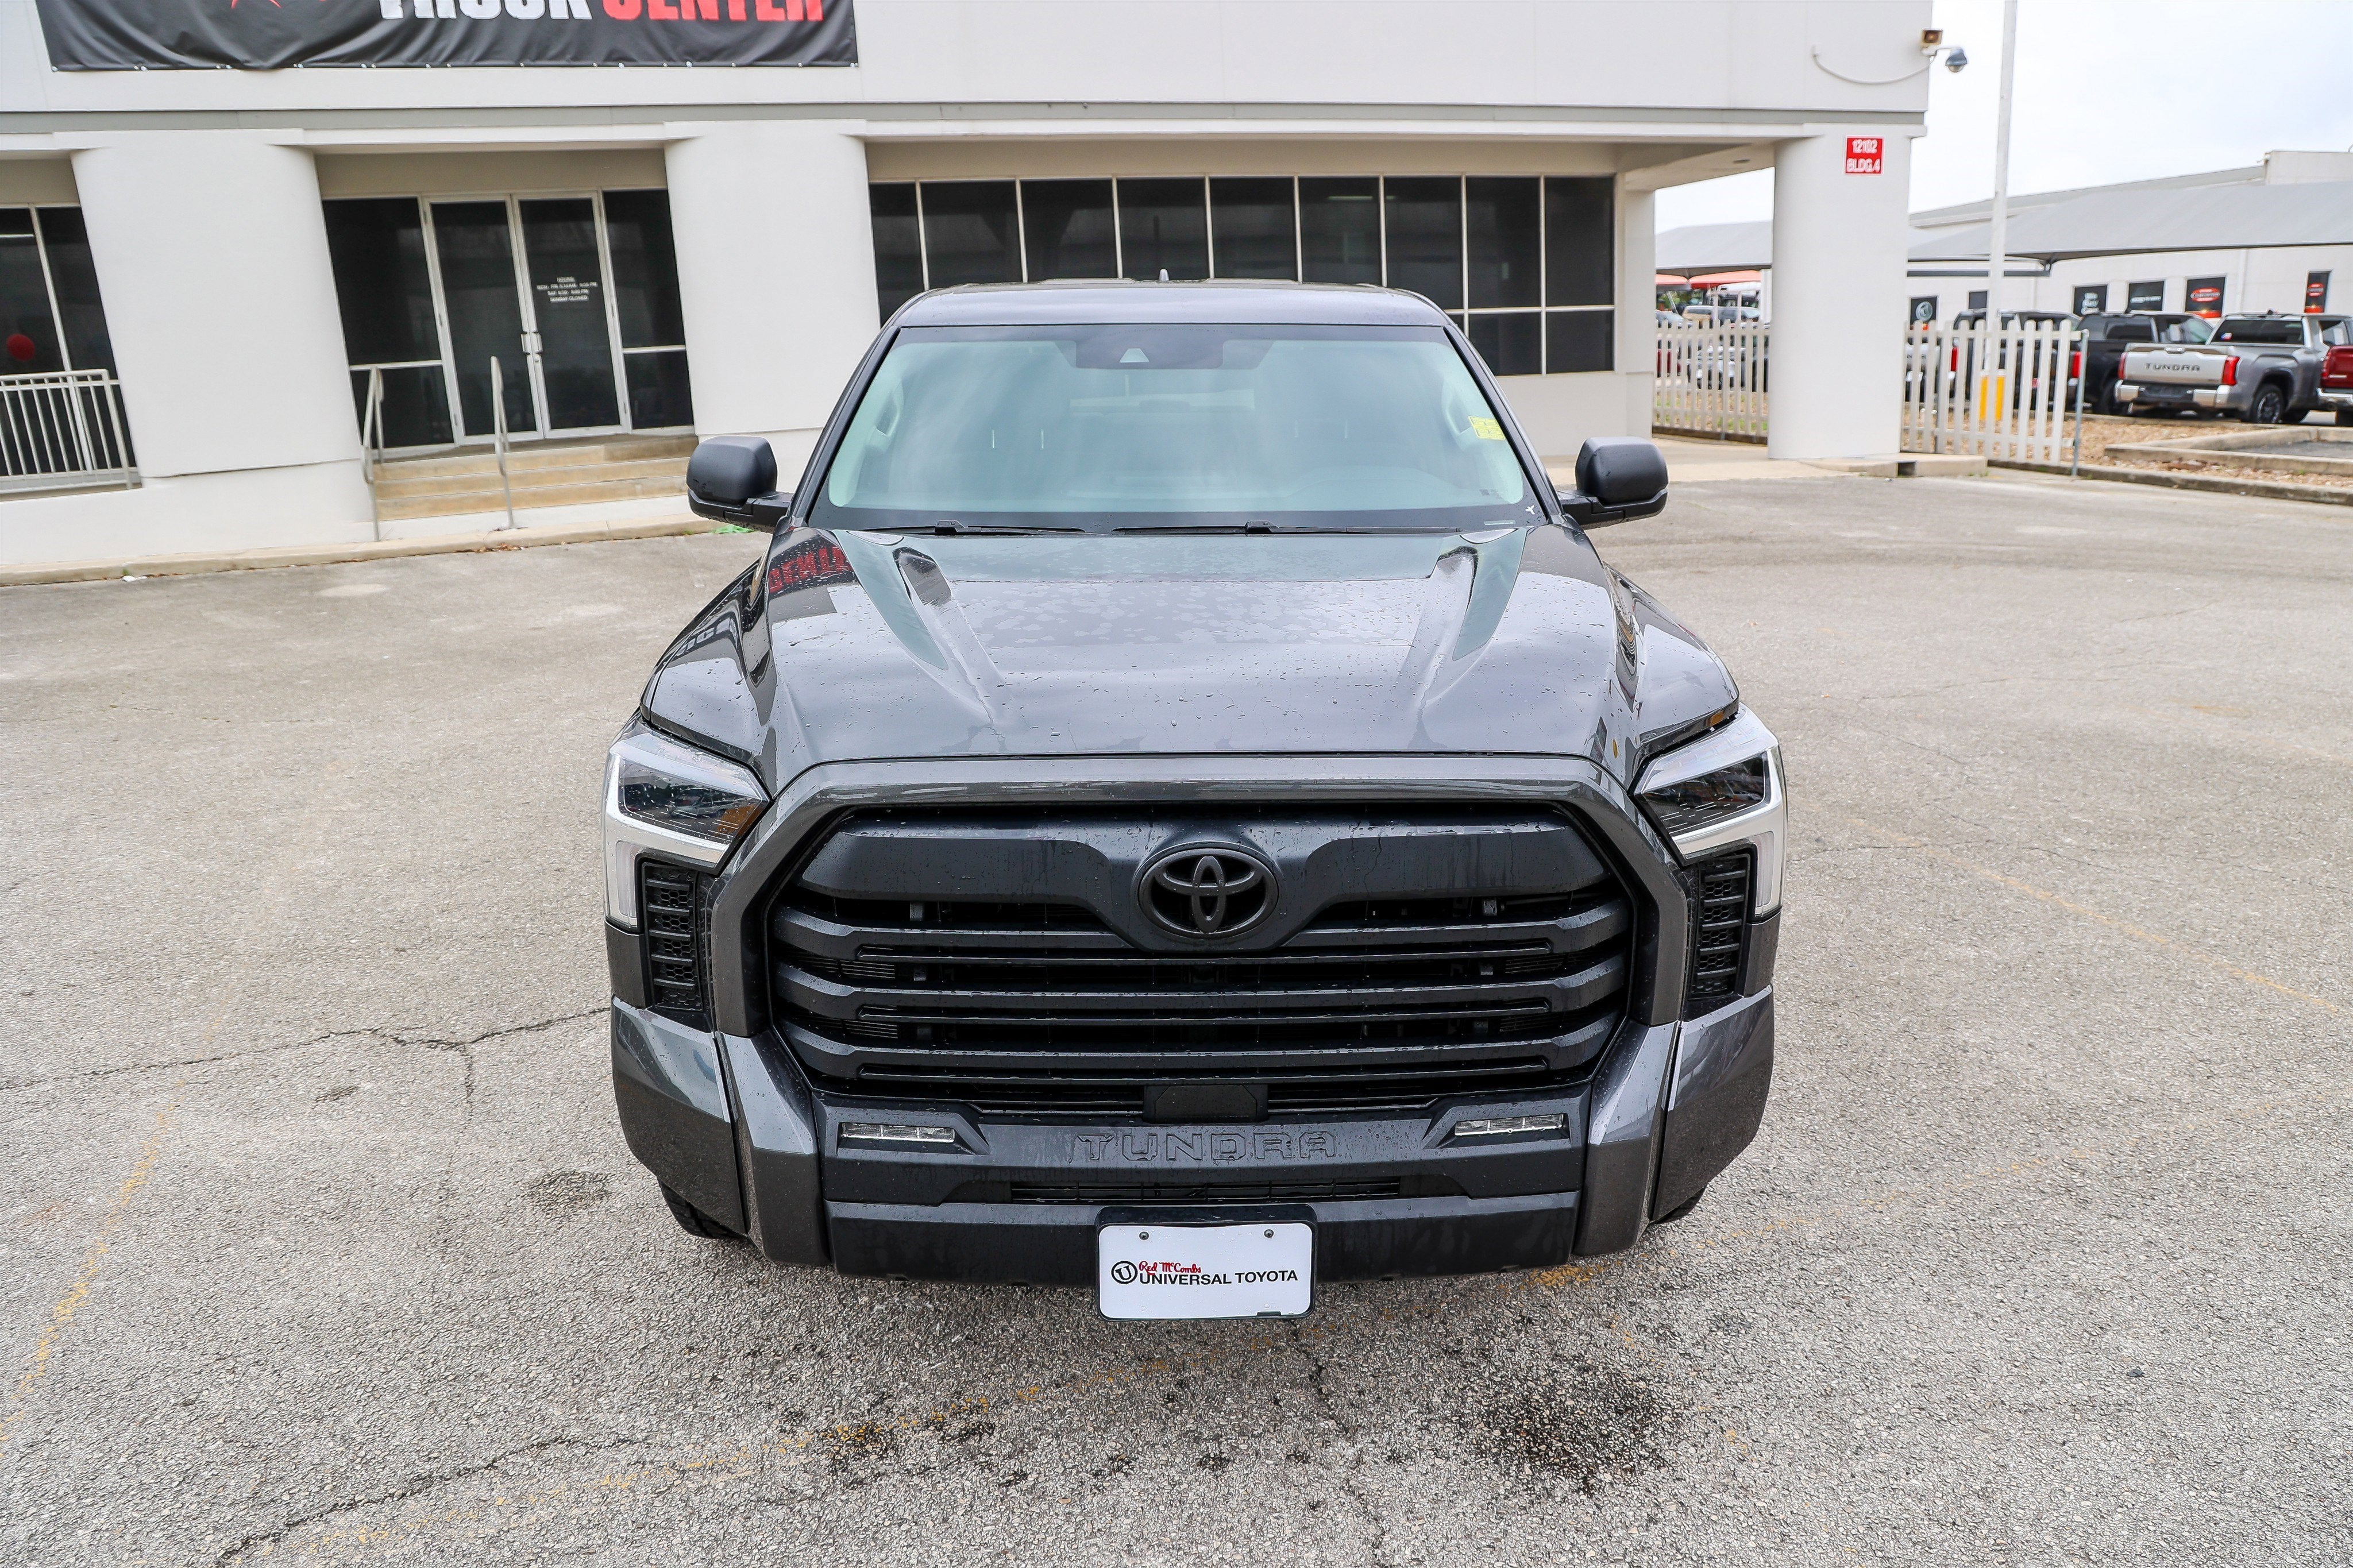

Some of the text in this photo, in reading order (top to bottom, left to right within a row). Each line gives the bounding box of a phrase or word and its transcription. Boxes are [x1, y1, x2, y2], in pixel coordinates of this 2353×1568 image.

[2145, 362, 2201, 372] TUNDRA
[1076, 1131, 1336, 1161] TUNDRA
[1139, 1261, 1157, 1275] Red
[1139, 1273, 1232, 1285] UNIVERSAL
[1235, 1270, 1298, 1284] TOYOTA
